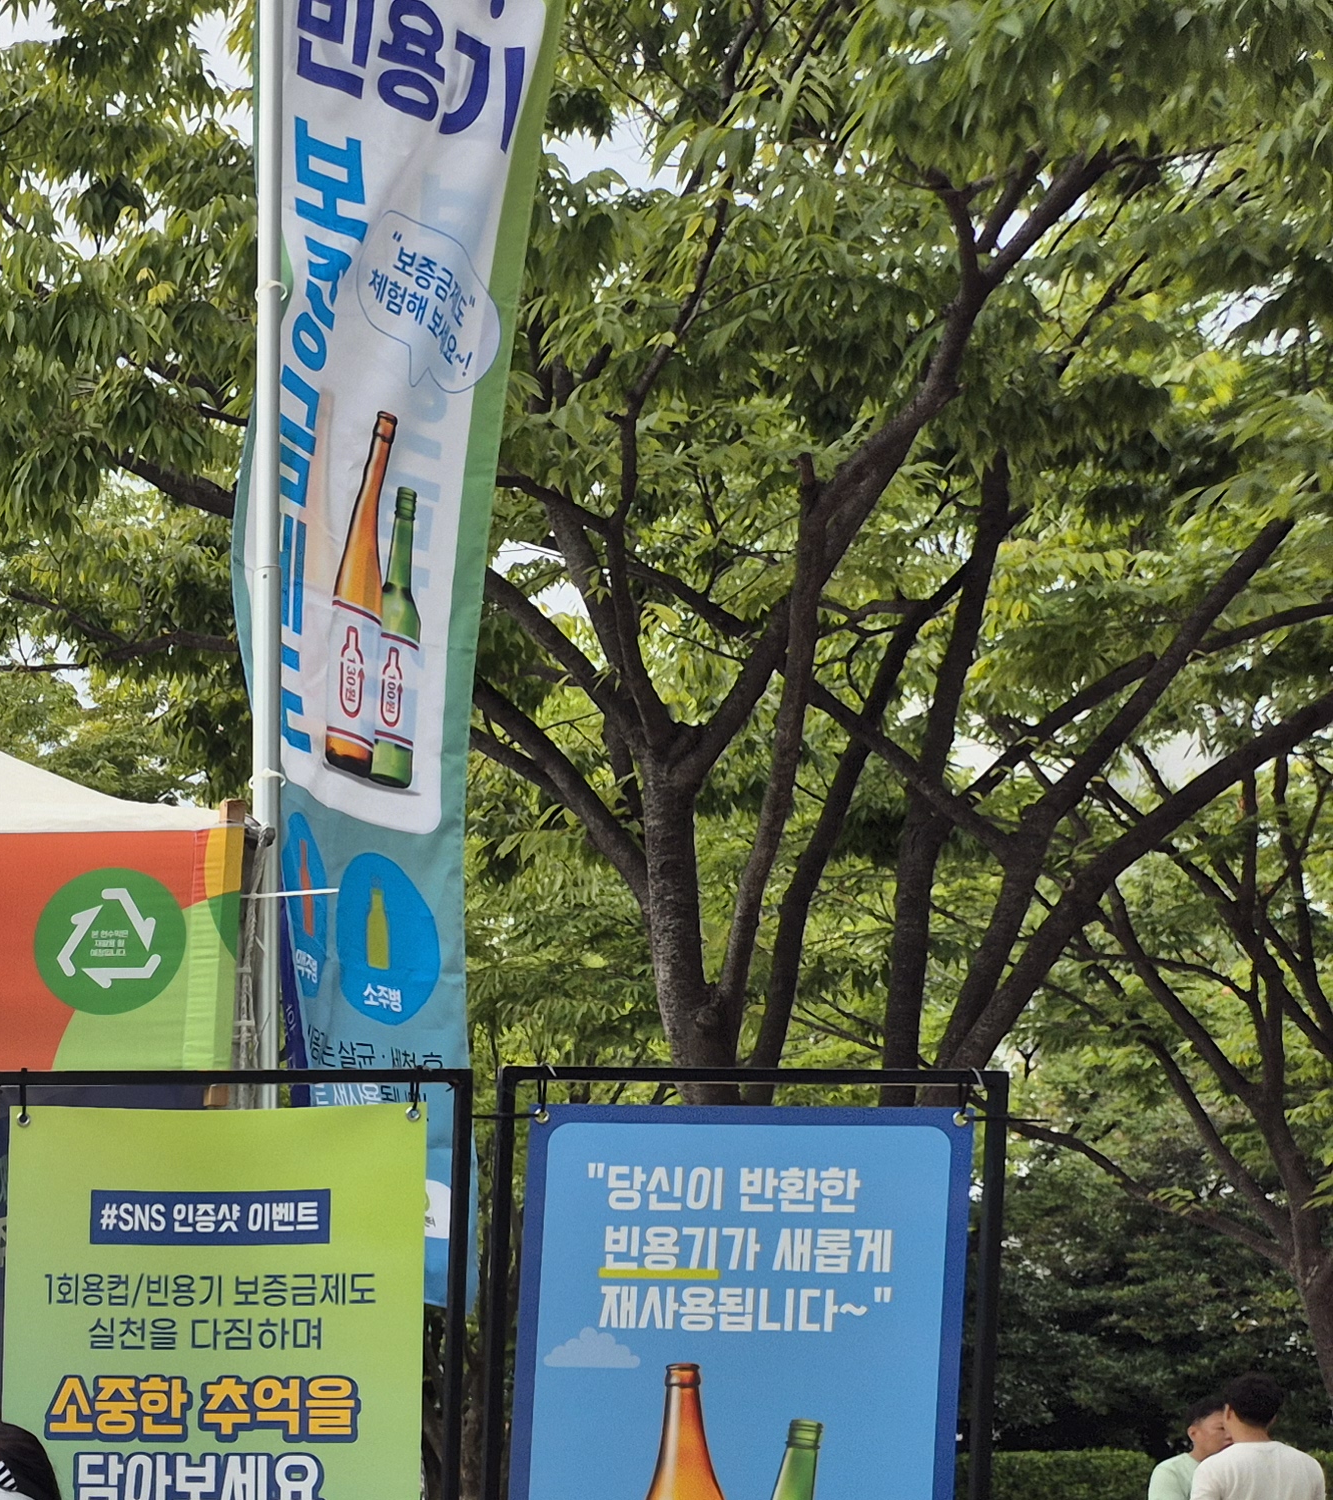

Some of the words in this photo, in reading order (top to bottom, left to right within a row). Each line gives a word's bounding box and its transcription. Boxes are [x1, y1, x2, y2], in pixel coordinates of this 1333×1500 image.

[368, 269, 429, 325] 체험해
[345, 656, 357, 703] 130원
[386, 674, 397, 715] 100원
[362, 982, 403, 1013] 소주병
[587, 1162, 723, 1212] "당신이
[738, 1166, 860, 1214] 반환한
[99, 1202, 166, 1232] #SNS
[173, 1202, 240, 1234] 인증샷
[247, 1200, 320, 1232] 이벤트
[603, 1225, 760, 1272] 빈용기가
[771, 1228, 893, 1274] 새롭게
[44, 1272, 223, 1308] 1회용컵/빈용기
[234, 1272, 377, 1306] 보증금제도
[598, 1285, 892, 1333] 재사용됩니다~"
[87, 1317, 179, 1351] 실천을
[191, 1317, 324, 1352] 다짐하며
[47, 1376, 191, 1438] 소중한
[202, 1376, 359, 1438] 추억을
